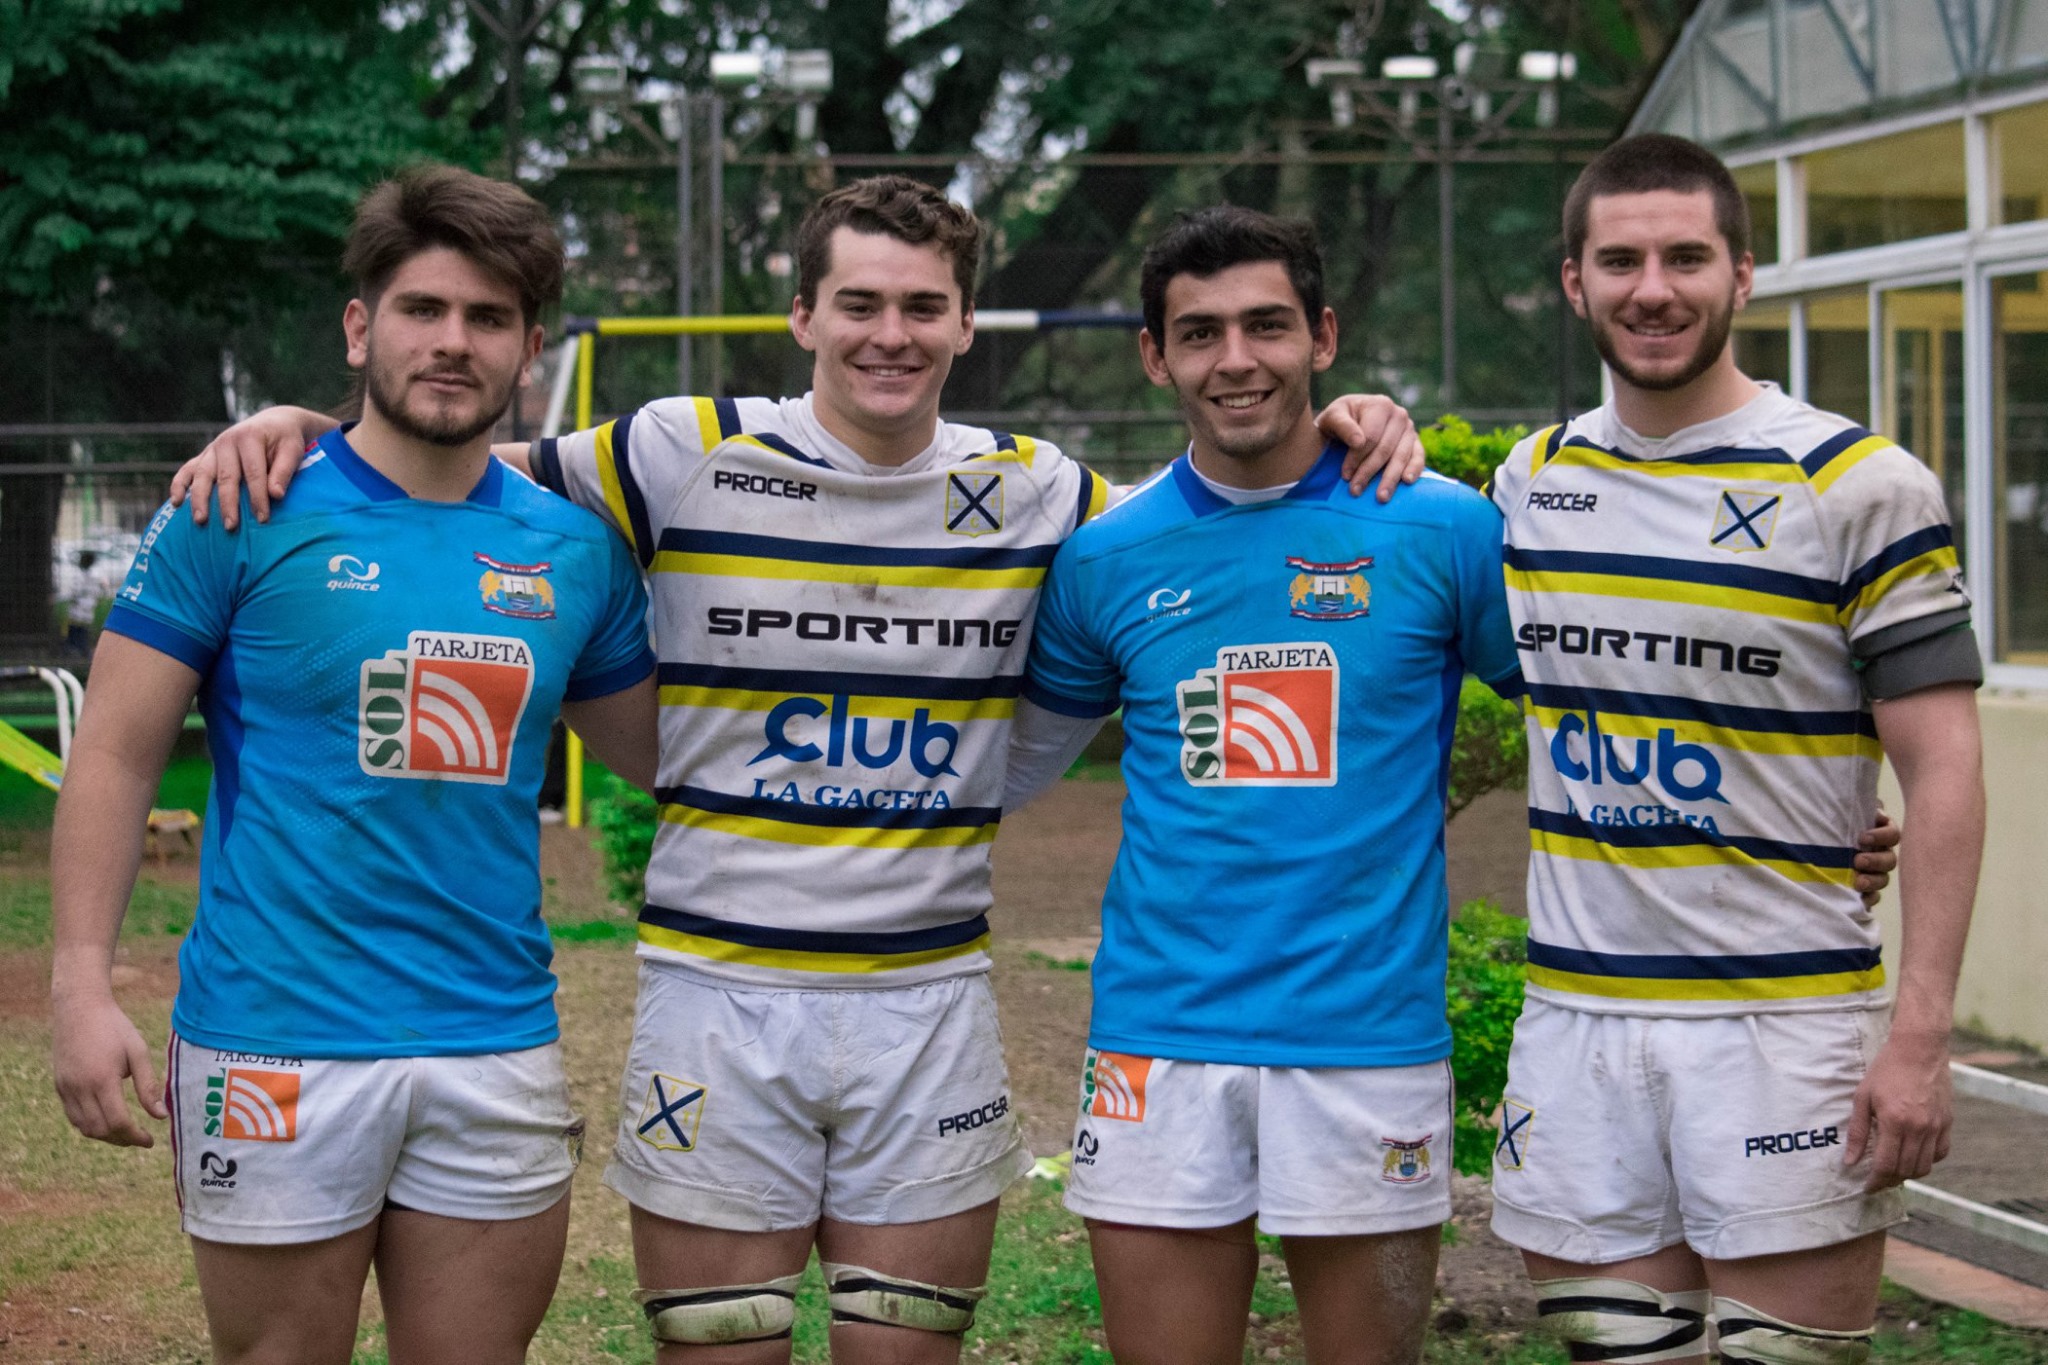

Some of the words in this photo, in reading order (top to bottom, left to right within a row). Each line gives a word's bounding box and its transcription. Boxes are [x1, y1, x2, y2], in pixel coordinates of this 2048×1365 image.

[713, 470, 818, 501] PROCER
[1527, 491, 1598, 513] PROCER
[327, 577, 380, 592] quince
[707, 606, 1022, 649] SPORTING
[413, 636, 530, 666] TARJETA
[1222, 647, 1333, 672] TARJETA
[1516, 622, 1783, 678] SPORTING
[363, 656, 408, 771] SOL
[1182, 674, 1221, 781] SOL
[745, 693, 961, 780] Club
[1550, 708, 1731, 805] Club
[752, 777, 805, 805] LA
[814, 784, 953, 811] GACETA
[203, 1066, 227, 1138] SOL
[938, 1095, 1009, 1138] PROCER
[1745, 1126, 1841, 1158] PROCER
[200, 1174, 237, 1189] quince
